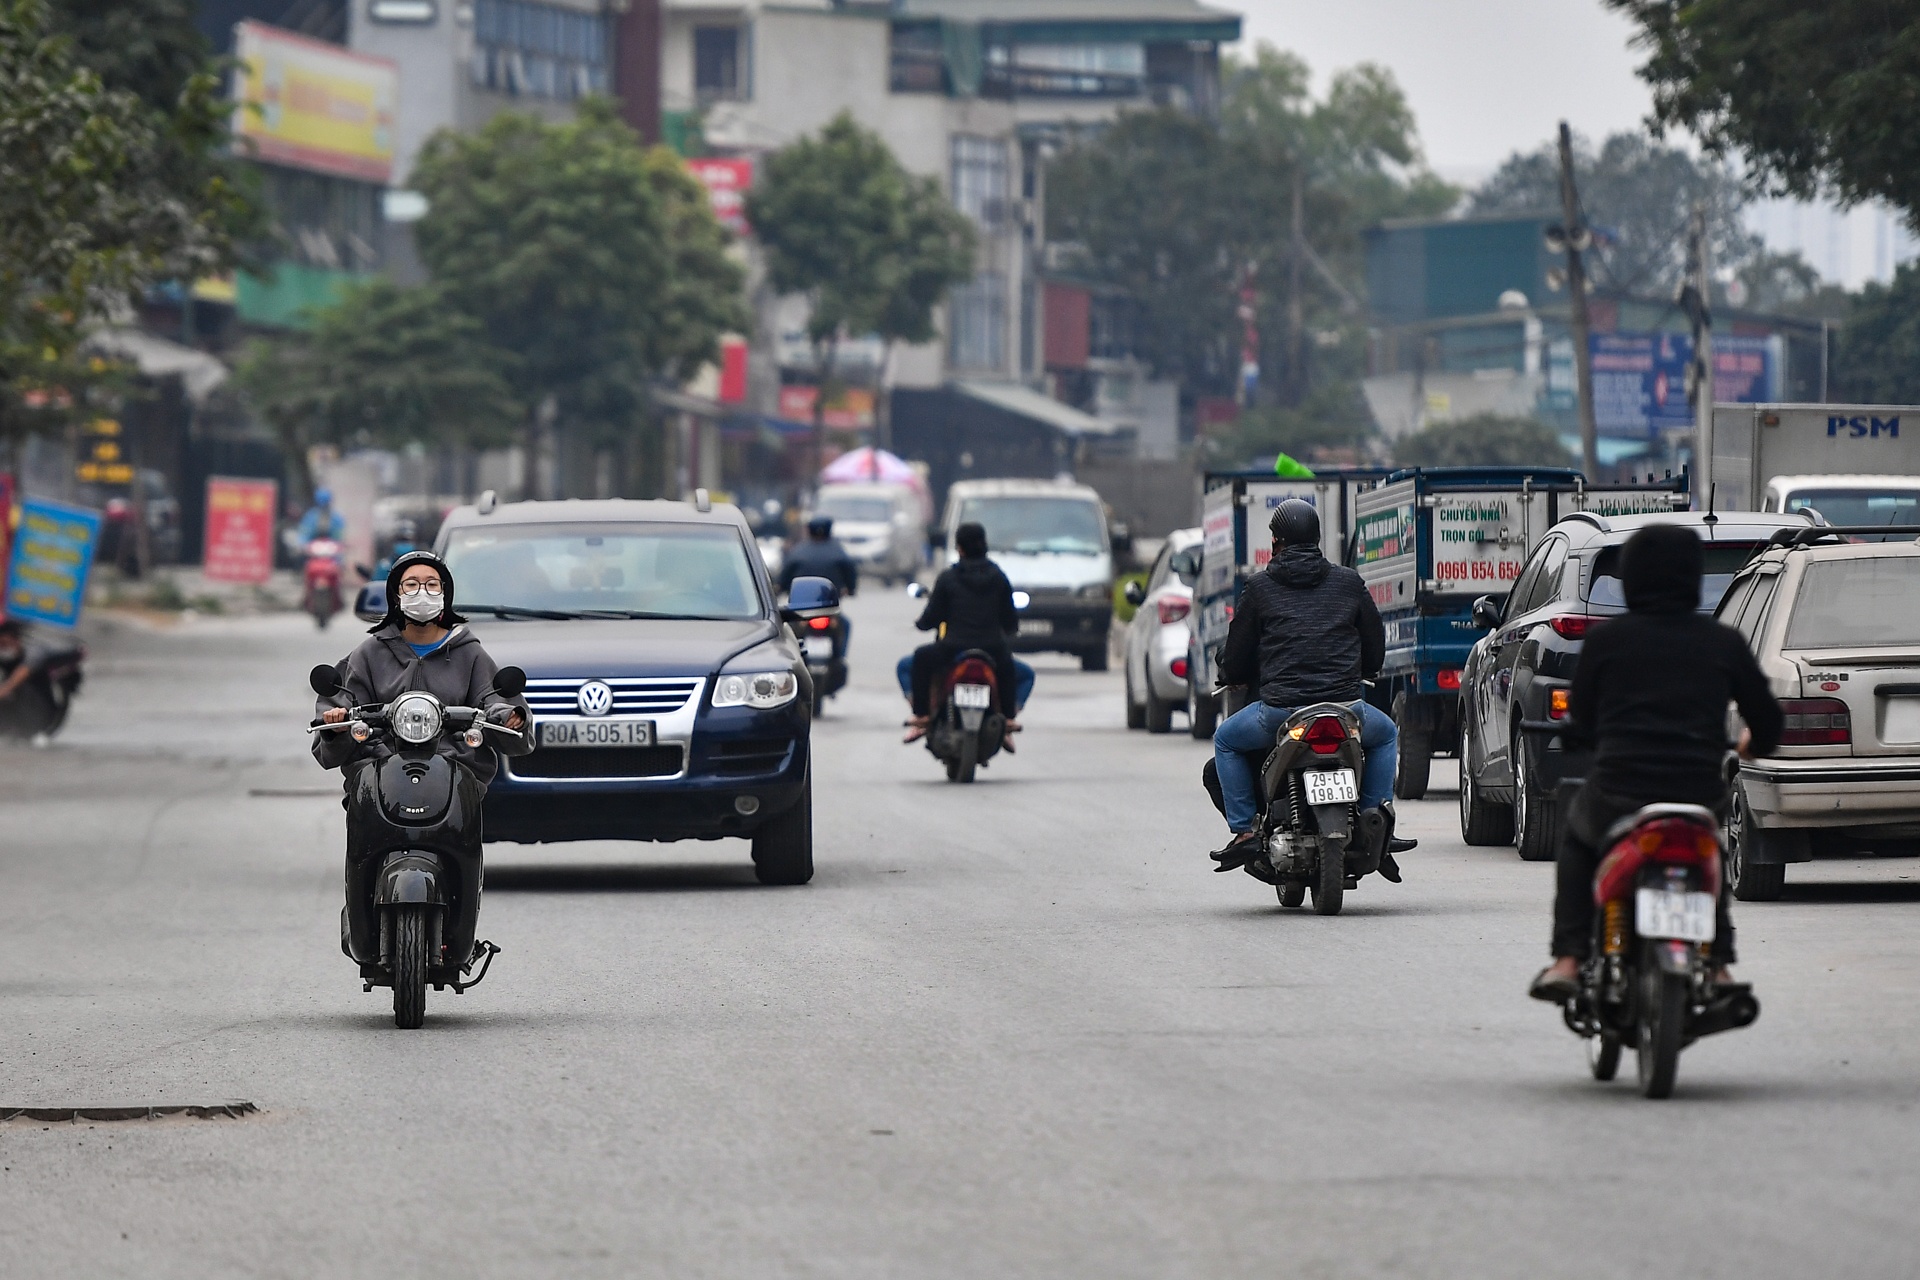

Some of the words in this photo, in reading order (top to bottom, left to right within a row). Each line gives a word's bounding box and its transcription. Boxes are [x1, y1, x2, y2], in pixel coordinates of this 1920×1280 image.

[1827, 415, 1900, 438] PSM
[1807, 672, 1838, 683] pride
[545, 724, 647, 743] 30A-505.15
[1312, 772, 1347, 787] 29-C1
[1311, 787, 1354, 802] 198.18
